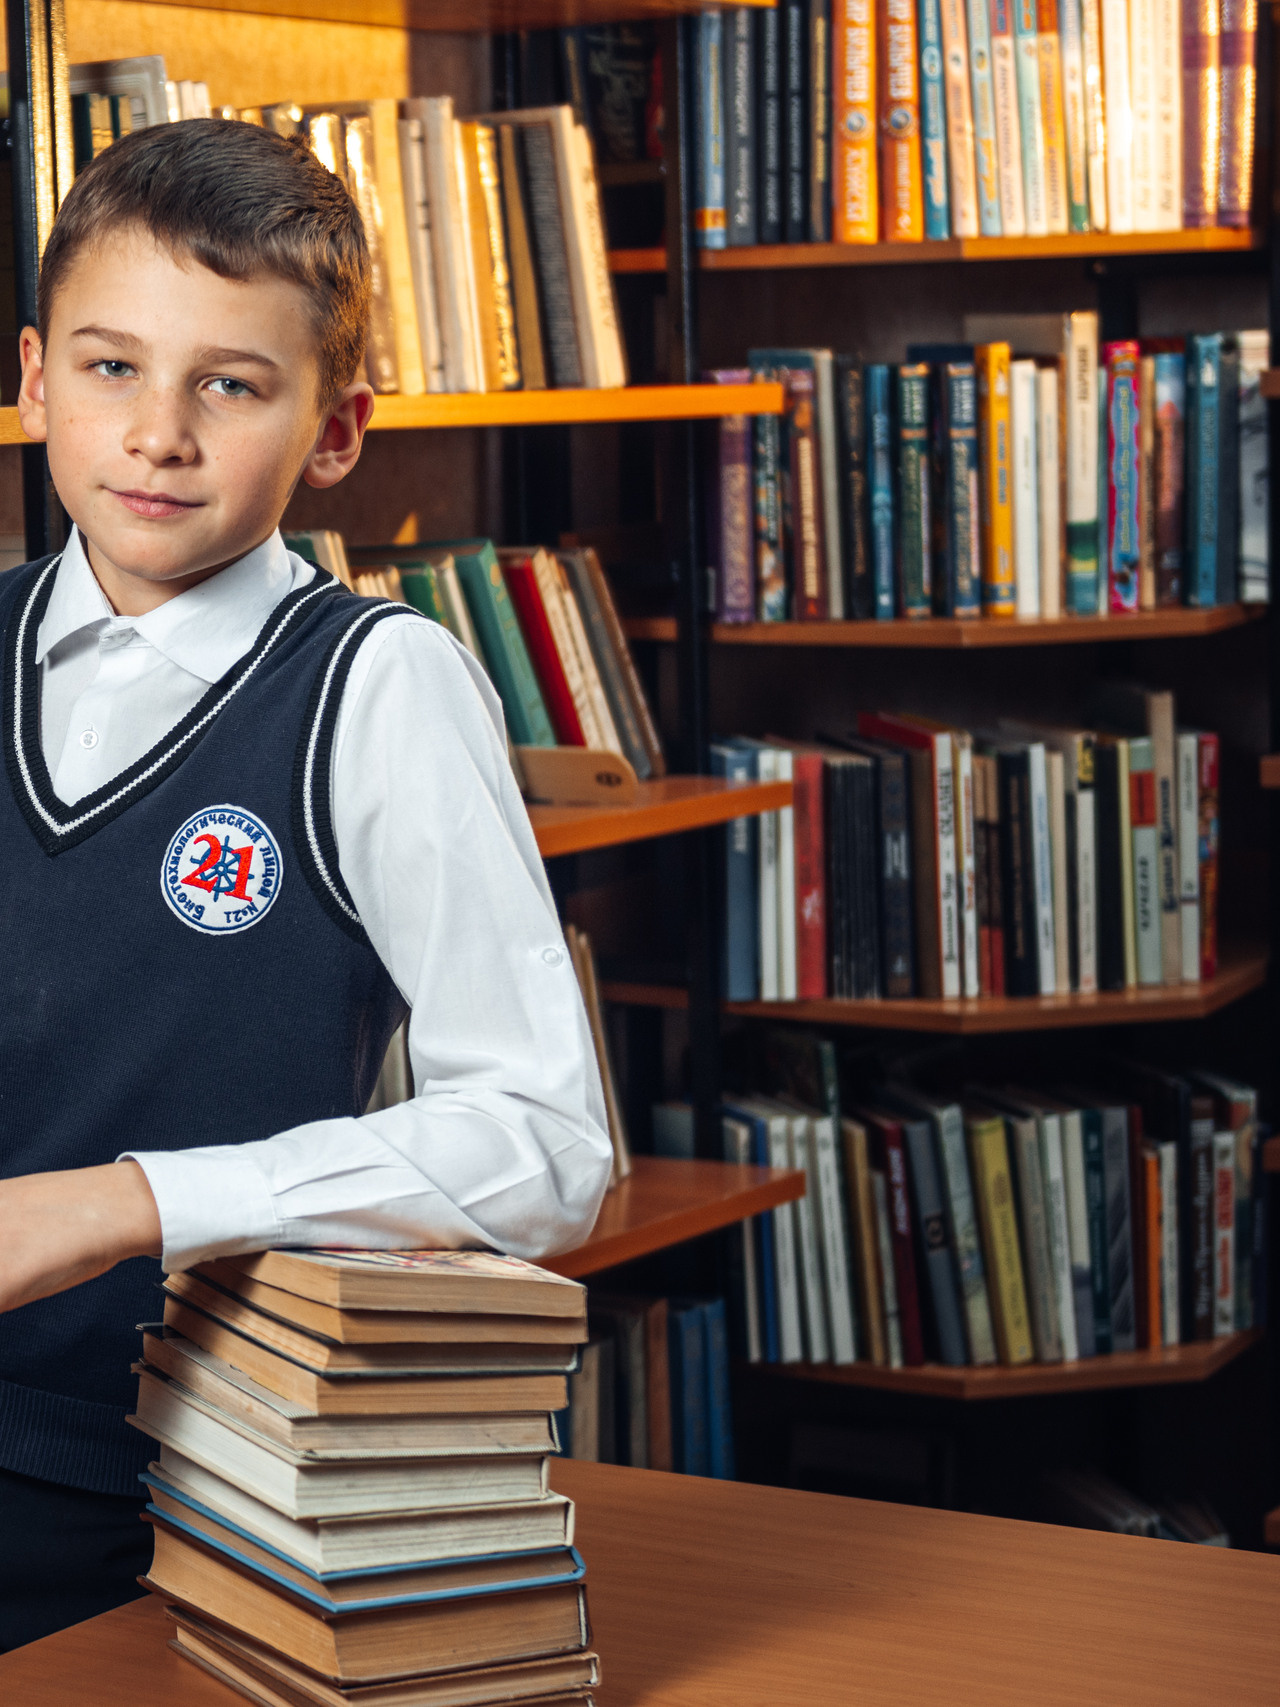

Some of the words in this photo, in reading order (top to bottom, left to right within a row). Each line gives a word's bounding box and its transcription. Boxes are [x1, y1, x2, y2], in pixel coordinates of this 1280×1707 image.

[168, 813, 263, 921] Биотехнологический
[180, 833, 254, 902] 21
[257, 845, 276, 898] лицей
[223, 901, 260, 924] №21
